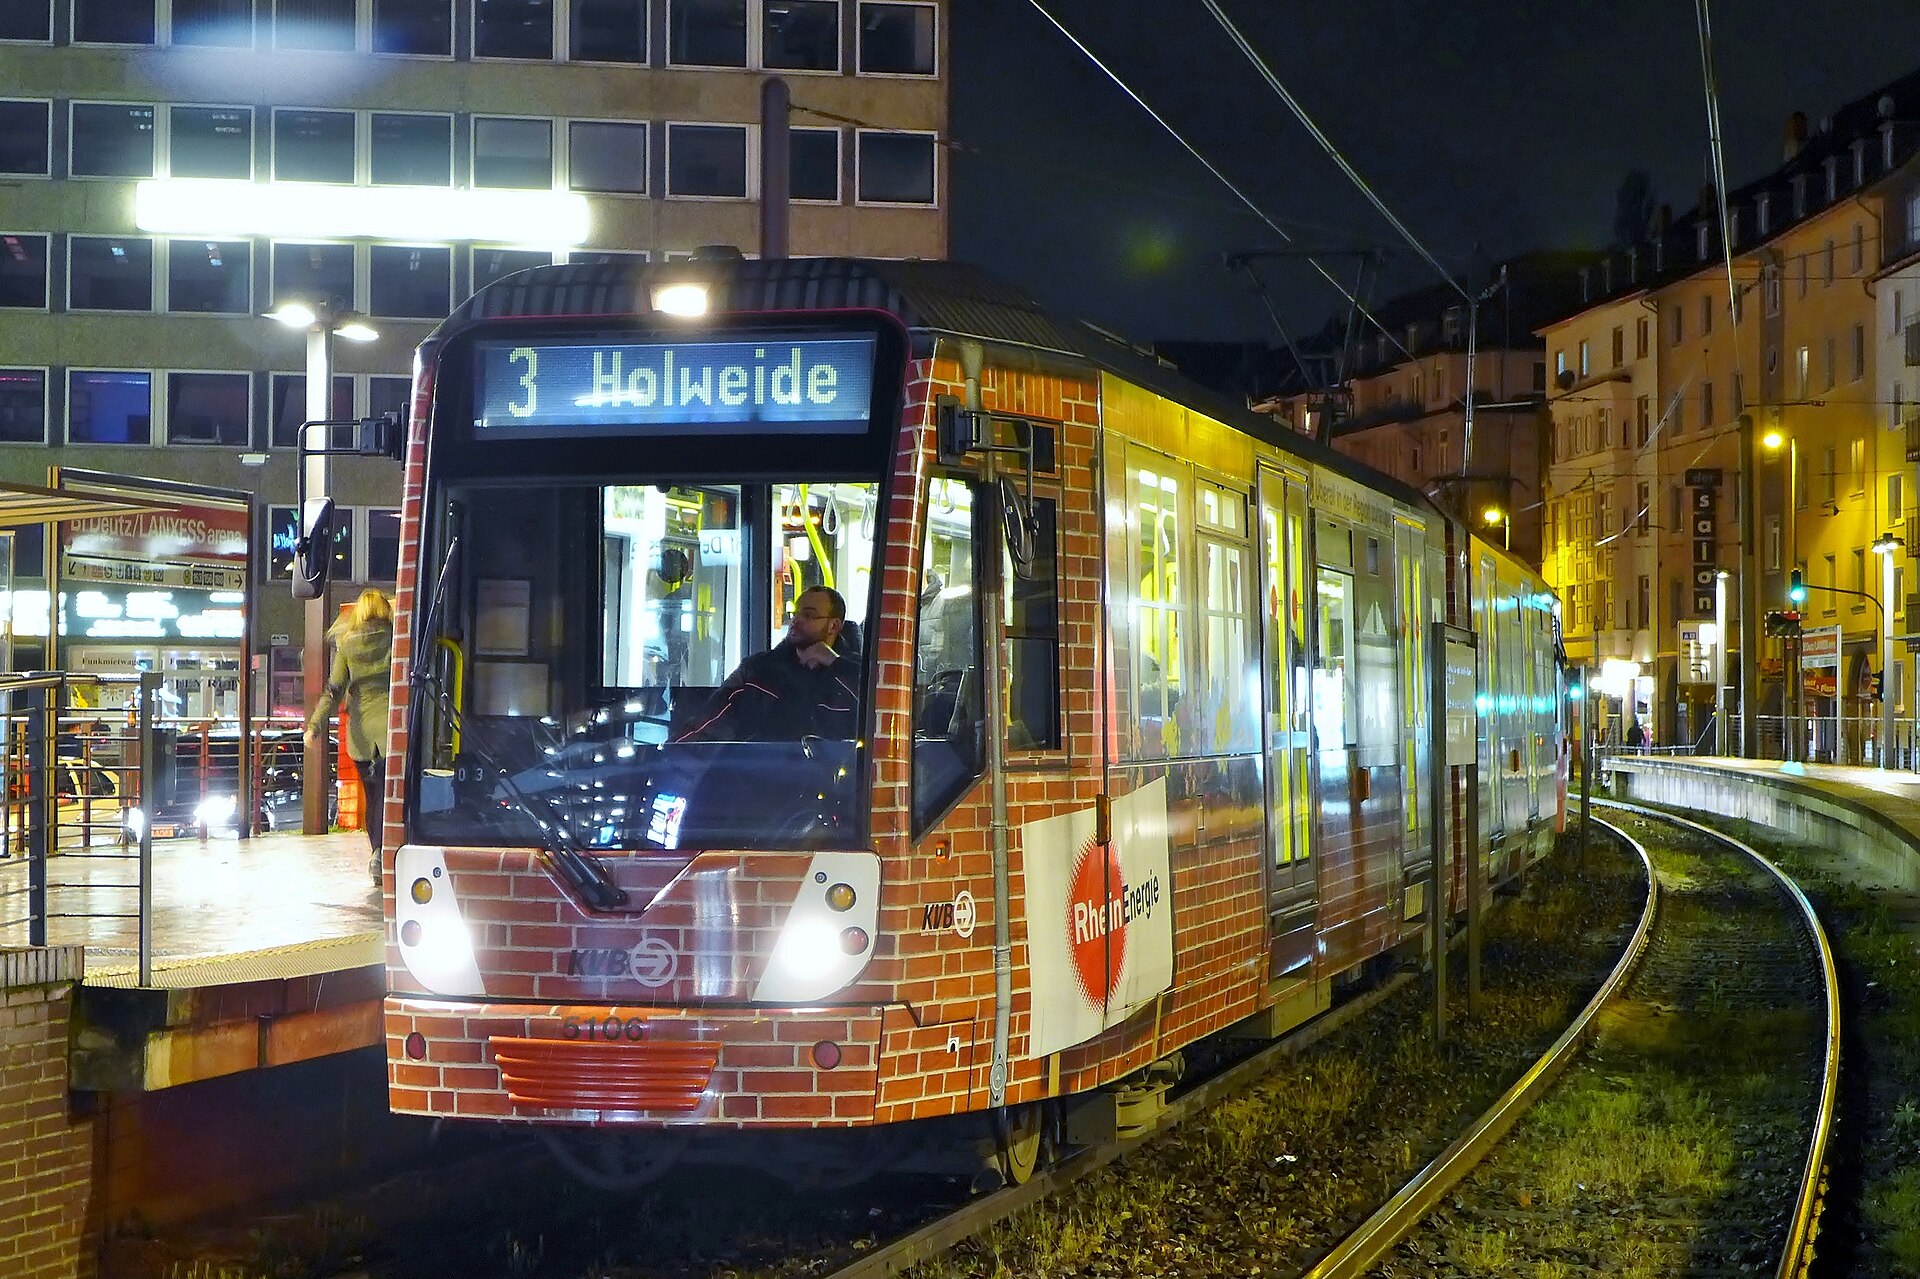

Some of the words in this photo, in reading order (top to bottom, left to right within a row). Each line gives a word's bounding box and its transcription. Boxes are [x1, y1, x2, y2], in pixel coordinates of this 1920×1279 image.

[508, 346, 538, 418] 3
[591, 346, 839, 408] Holweide
[1696, 493, 1713, 611] salon
[922, 902, 955, 931] KVB
[1074, 869, 1160, 945] RheinEnergie
[566, 949, 629, 976] KVB
[563, 1016, 644, 1042] 5106
